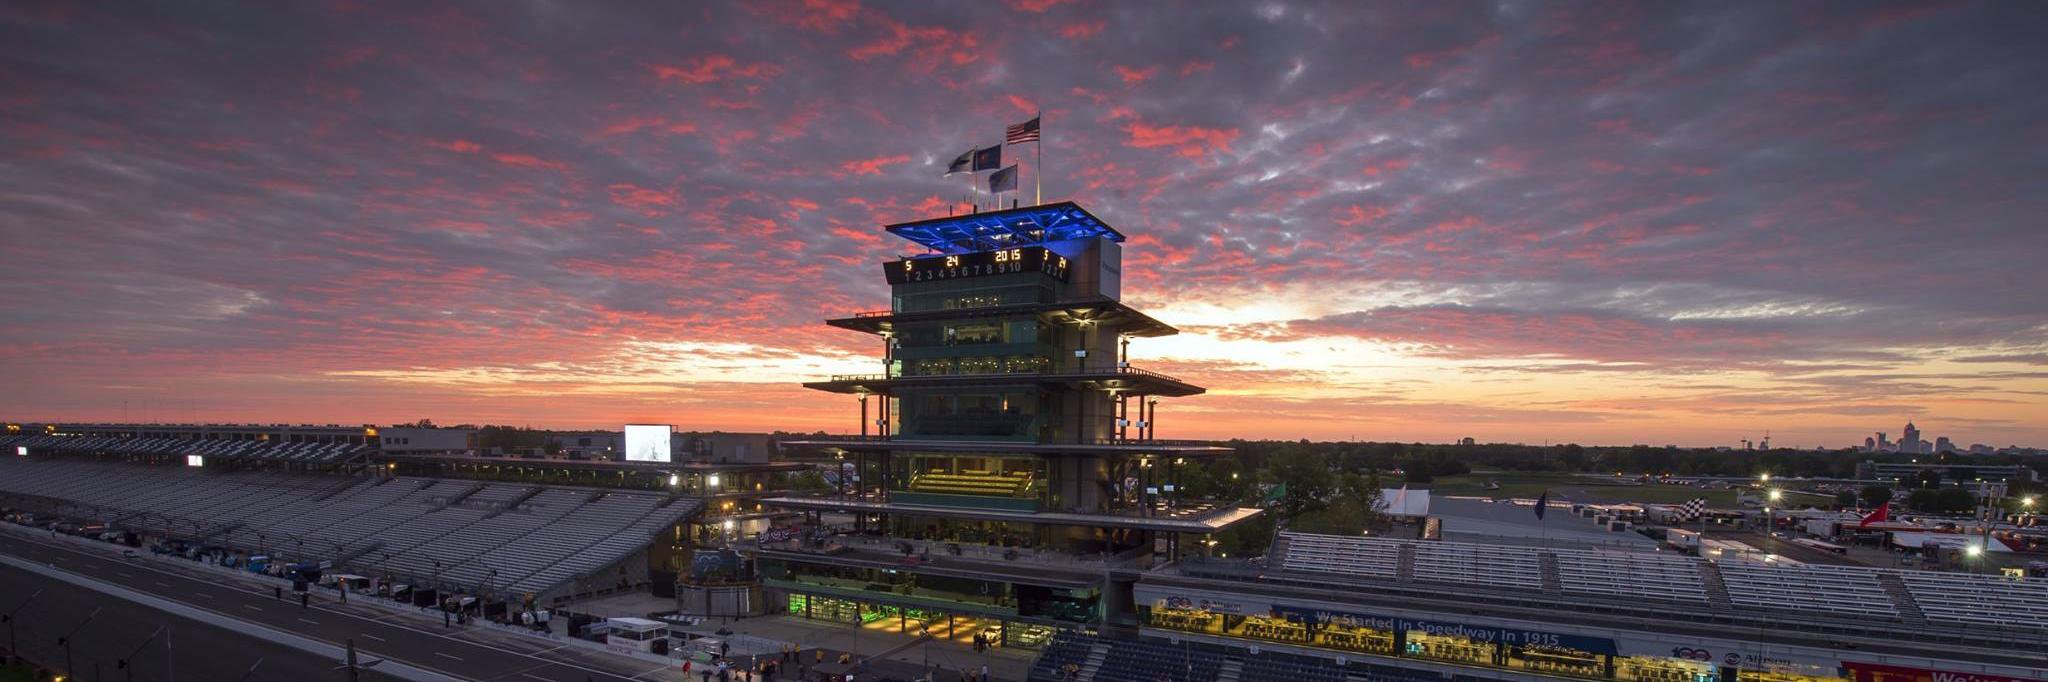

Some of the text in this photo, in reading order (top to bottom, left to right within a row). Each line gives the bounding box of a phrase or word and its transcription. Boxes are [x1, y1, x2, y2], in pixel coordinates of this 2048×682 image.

[905, 260, 912, 271] 5
[946, 256, 959, 267] 24
[915, 271, 922, 281] 2
[927, 270, 933, 280] 3
[950, 268, 956, 278] 5
[962, 267, 968, 277] 6
[974, 265, 980, 275] 7
[986, 264, 993, 274] 8
[998, 263, 1005, 273] 9
[1009, 262, 1021, 272] 10
[1316, 611, 1560, 645] We Started In Speedway In 1915
